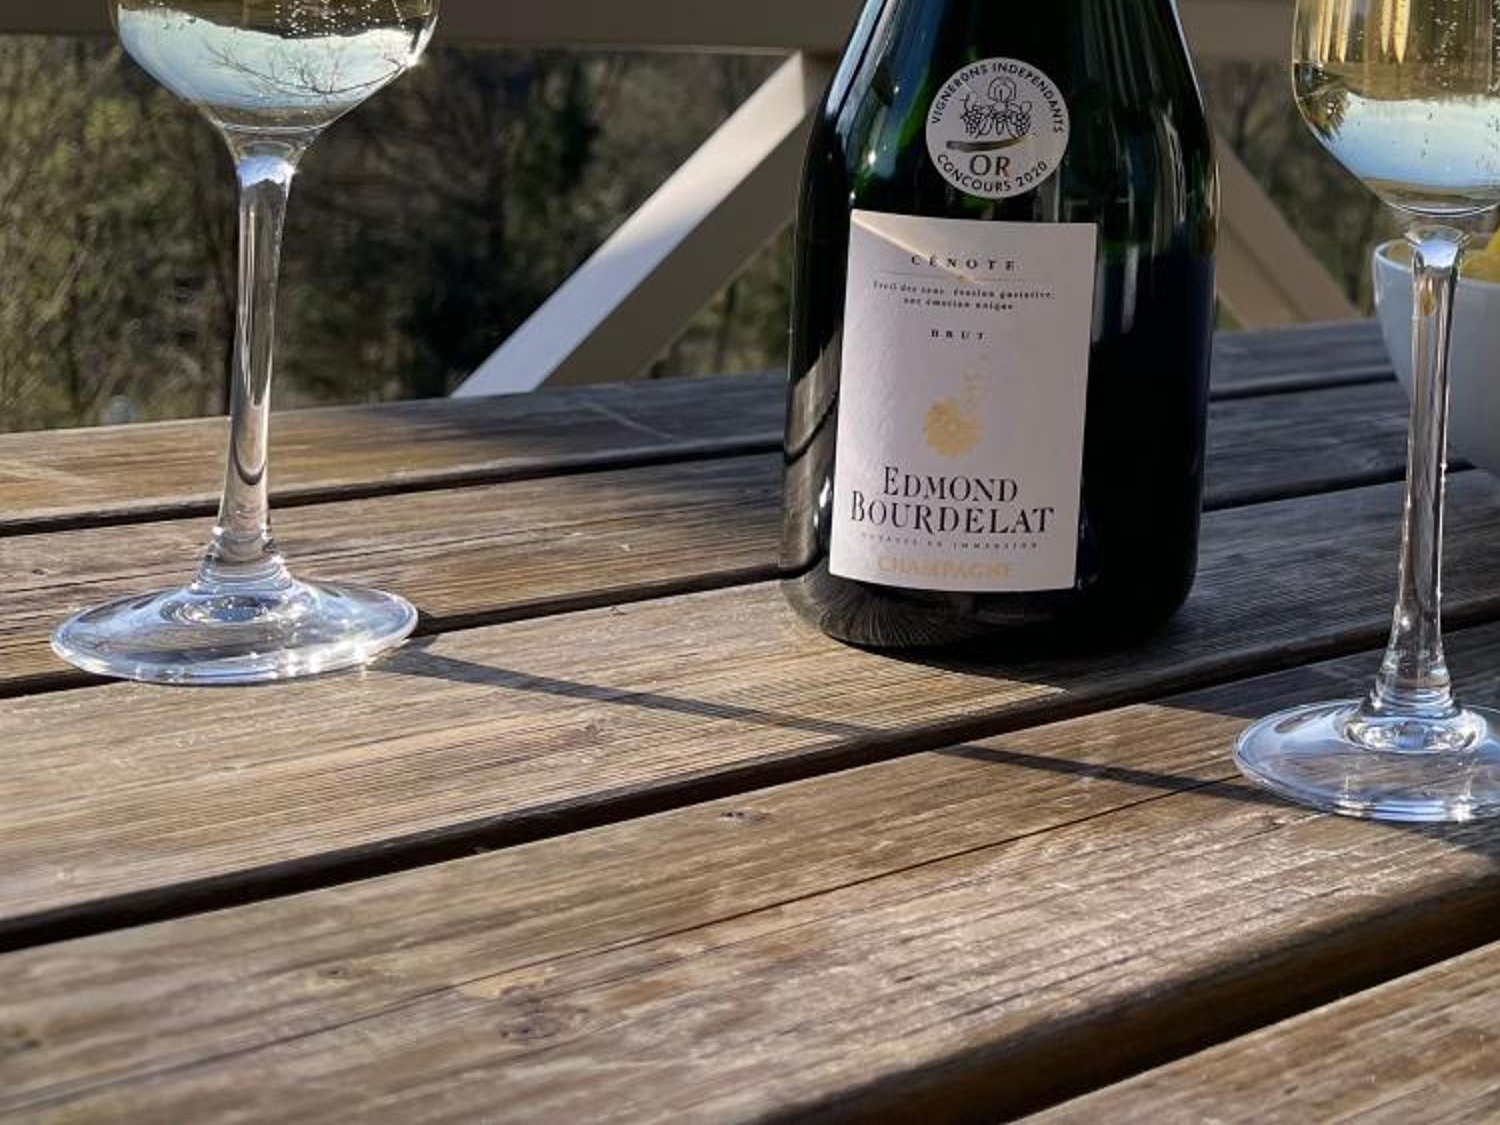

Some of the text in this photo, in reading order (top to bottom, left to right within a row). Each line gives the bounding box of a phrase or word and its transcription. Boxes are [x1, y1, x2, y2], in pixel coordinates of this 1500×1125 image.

[931, 61, 1065, 134] VIGNERONS INDEPENDANTS
[936, 153, 1048, 193] CONCOURS 2020
[969, 154, 1012, 178] OR
[931, 329, 984, 341] BRUT
[883, 466, 1018, 503] EDMOND
[850, 491, 1055, 536] BOURDELAT
